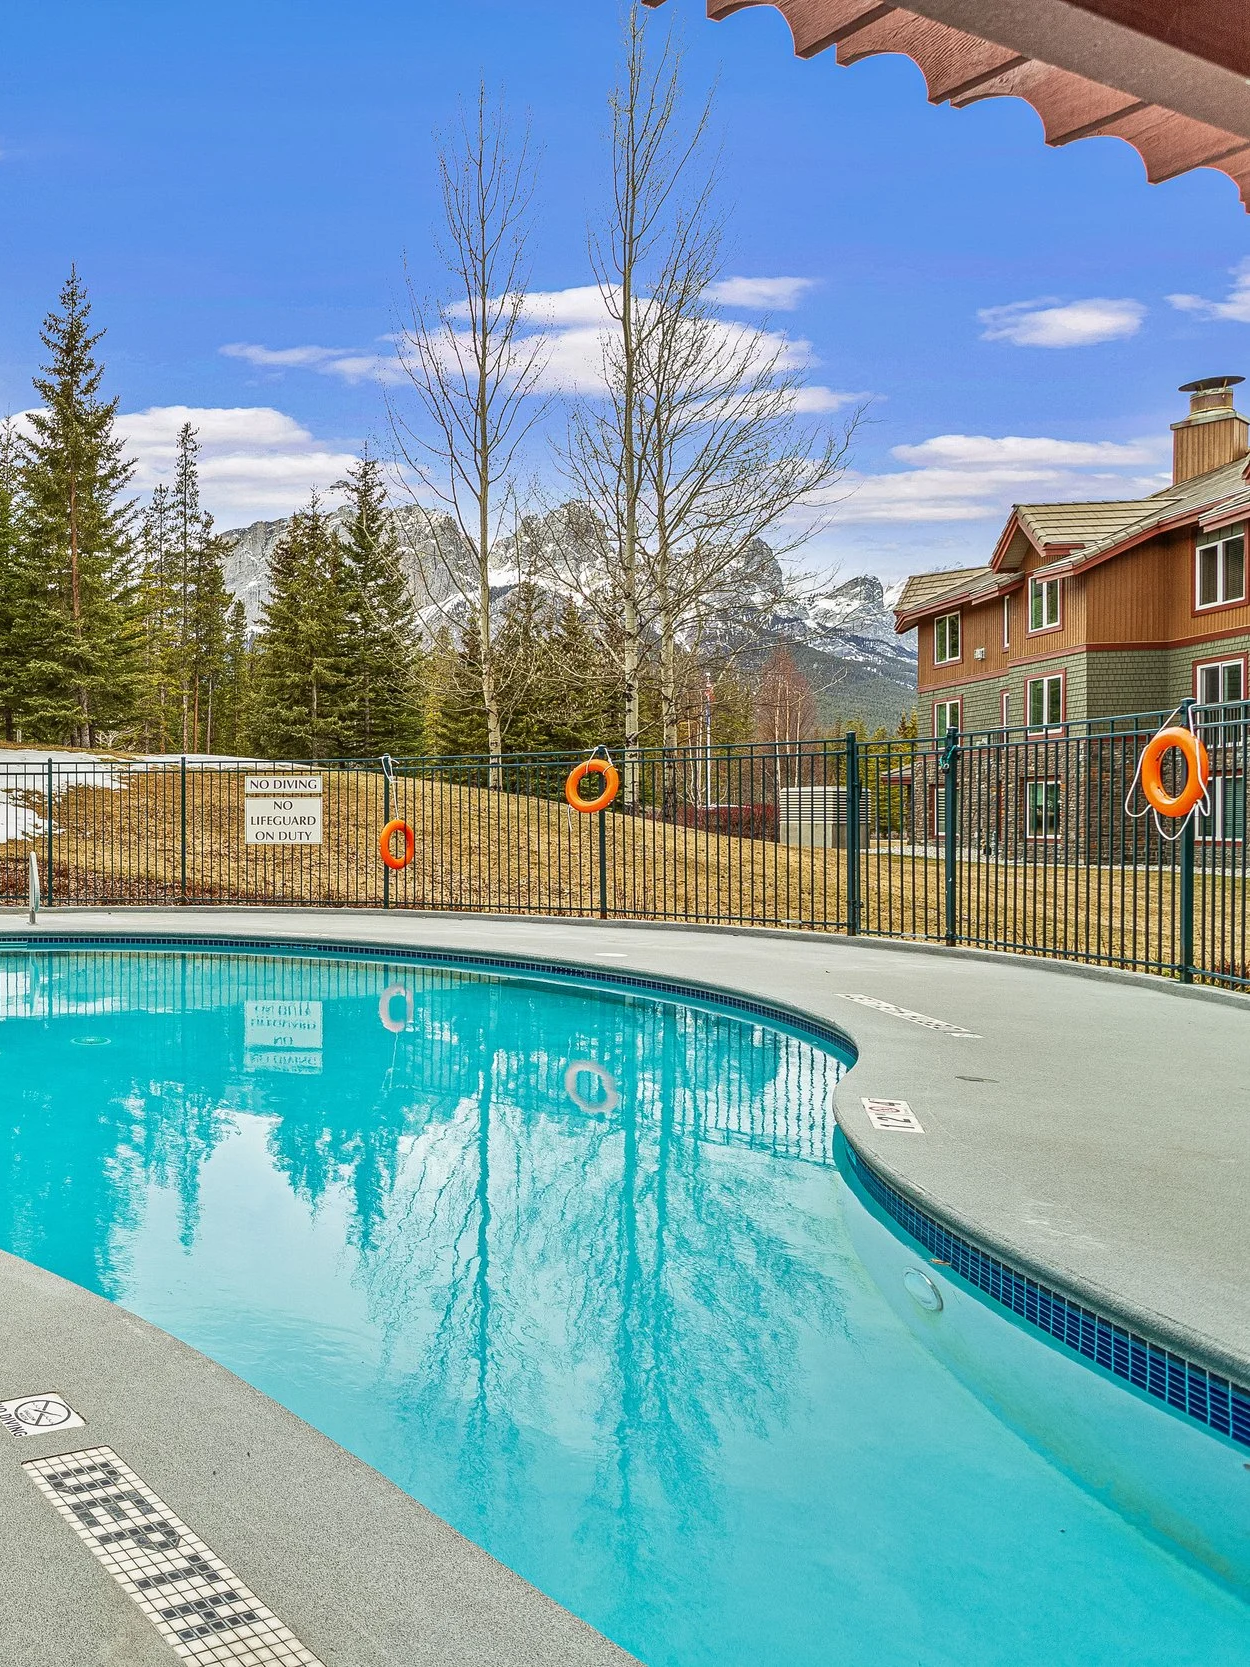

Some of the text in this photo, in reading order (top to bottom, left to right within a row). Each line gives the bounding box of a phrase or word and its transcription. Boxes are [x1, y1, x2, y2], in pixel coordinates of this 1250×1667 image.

[250, 779, 317, 790] NO DIVING
[273, 800, 293, 811] NO
[250, 815, 317, 826] LIFEGUARD
[255, 831, 312, 841] ON DUTY
[45, 1460, 259, 1641] DEPTH
